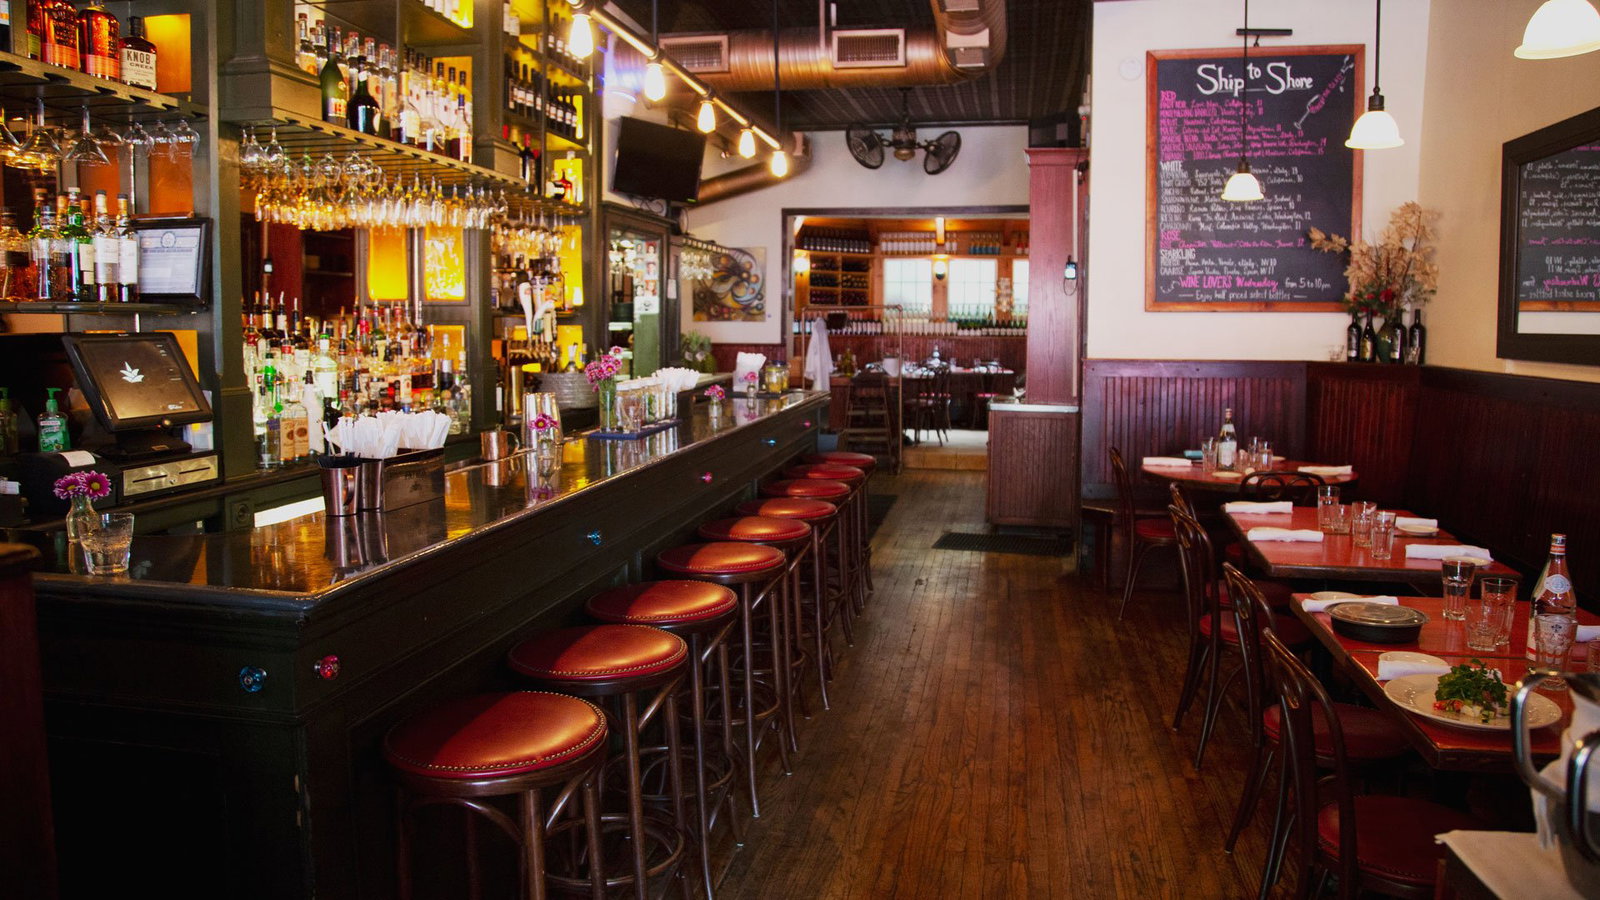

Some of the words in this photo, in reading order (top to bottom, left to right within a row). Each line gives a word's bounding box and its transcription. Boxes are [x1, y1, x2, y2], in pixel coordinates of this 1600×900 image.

[127, 50, 151, 64] KNOB
[1197, 63, 1245, 97] Ship
[1247, 62, 1261, 79] to
[1265, 62, 1313, 95] Shore
[1160, 90, 1177, 101] RED
[1160, 160, 1184, 171] WHITE
[1160, 248, 1196, 260] SPARKLING
[1179, 275, 1201, 289] WINE
[1235, 275, 1278, 293] Wednesday
[1285, 276, 1297, 289] from
[1299, 276, 1306, 289] 5
[1307, 278, 1314, 289] to
[1196, 289, 1213, 303] Enjoy
[1214, 289, 1228, 300] half
[1229, 289, 1248, 302] priced
[1249, 289, 1267, 300] select
[1268, 288, 1291, 301] bottles
